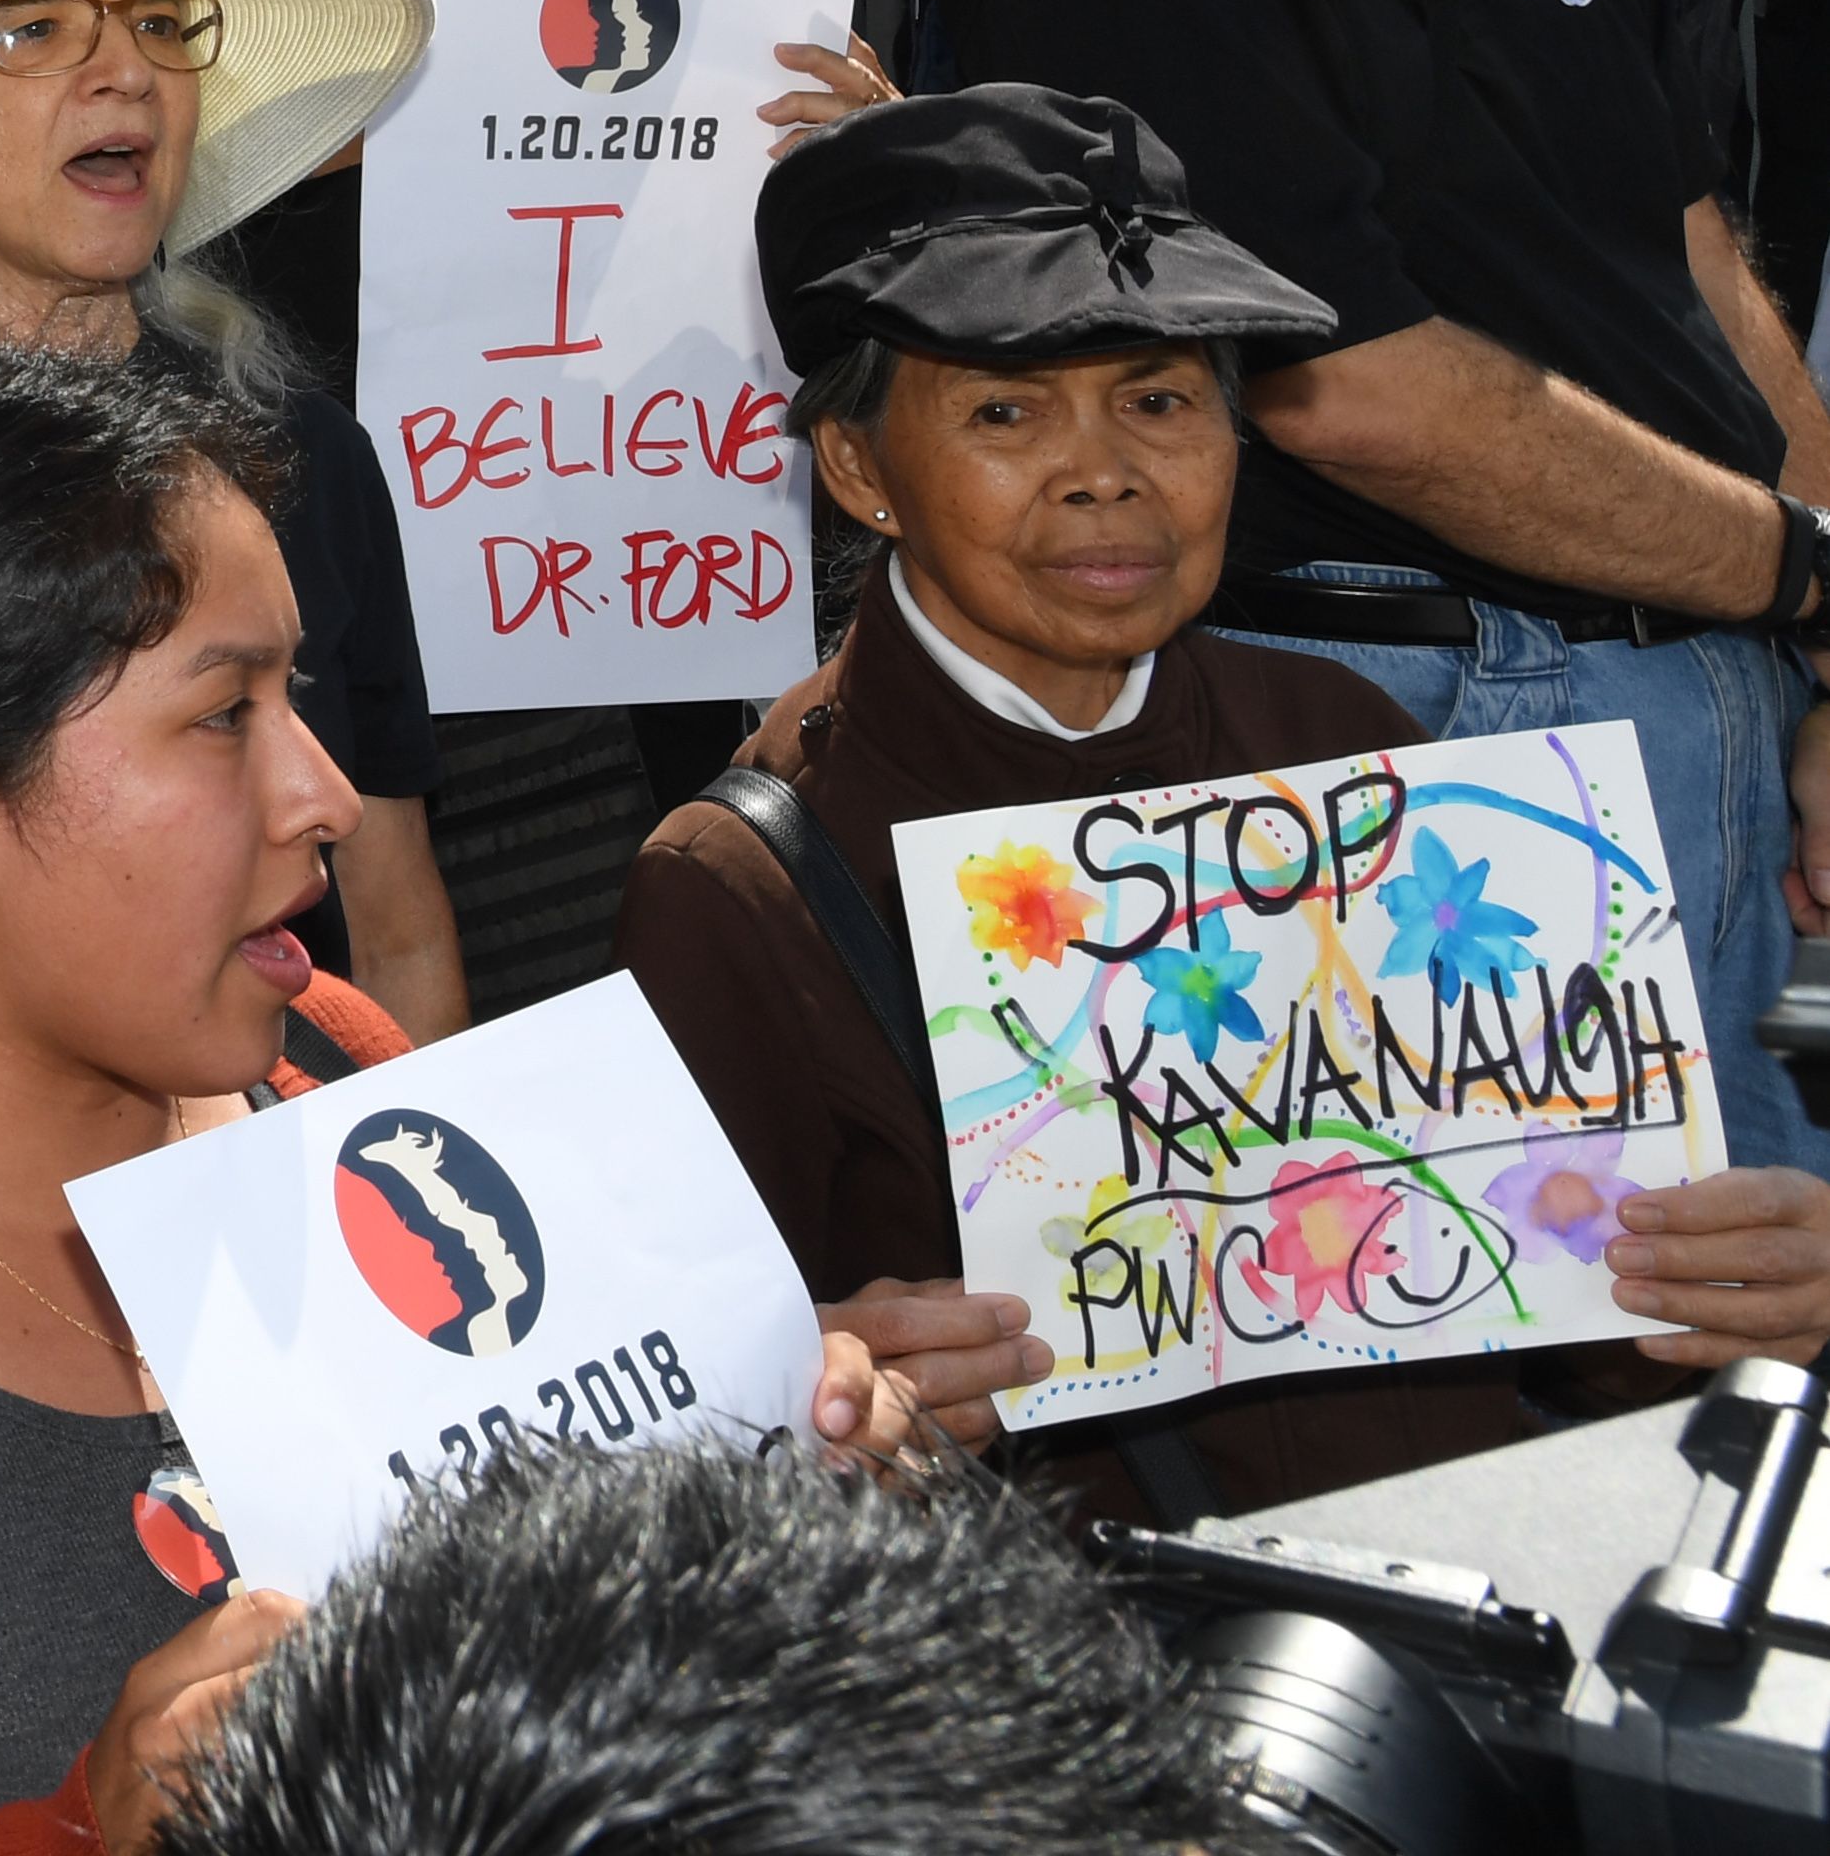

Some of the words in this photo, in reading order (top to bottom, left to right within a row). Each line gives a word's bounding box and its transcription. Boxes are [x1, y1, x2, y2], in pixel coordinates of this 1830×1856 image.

[482, 114, 719, 161] 1.20.2018
[482, 203, 624, 363] I
[399, 381, 791, 510] BELIEVE
[1067, 773, 1409, 962] STOP
